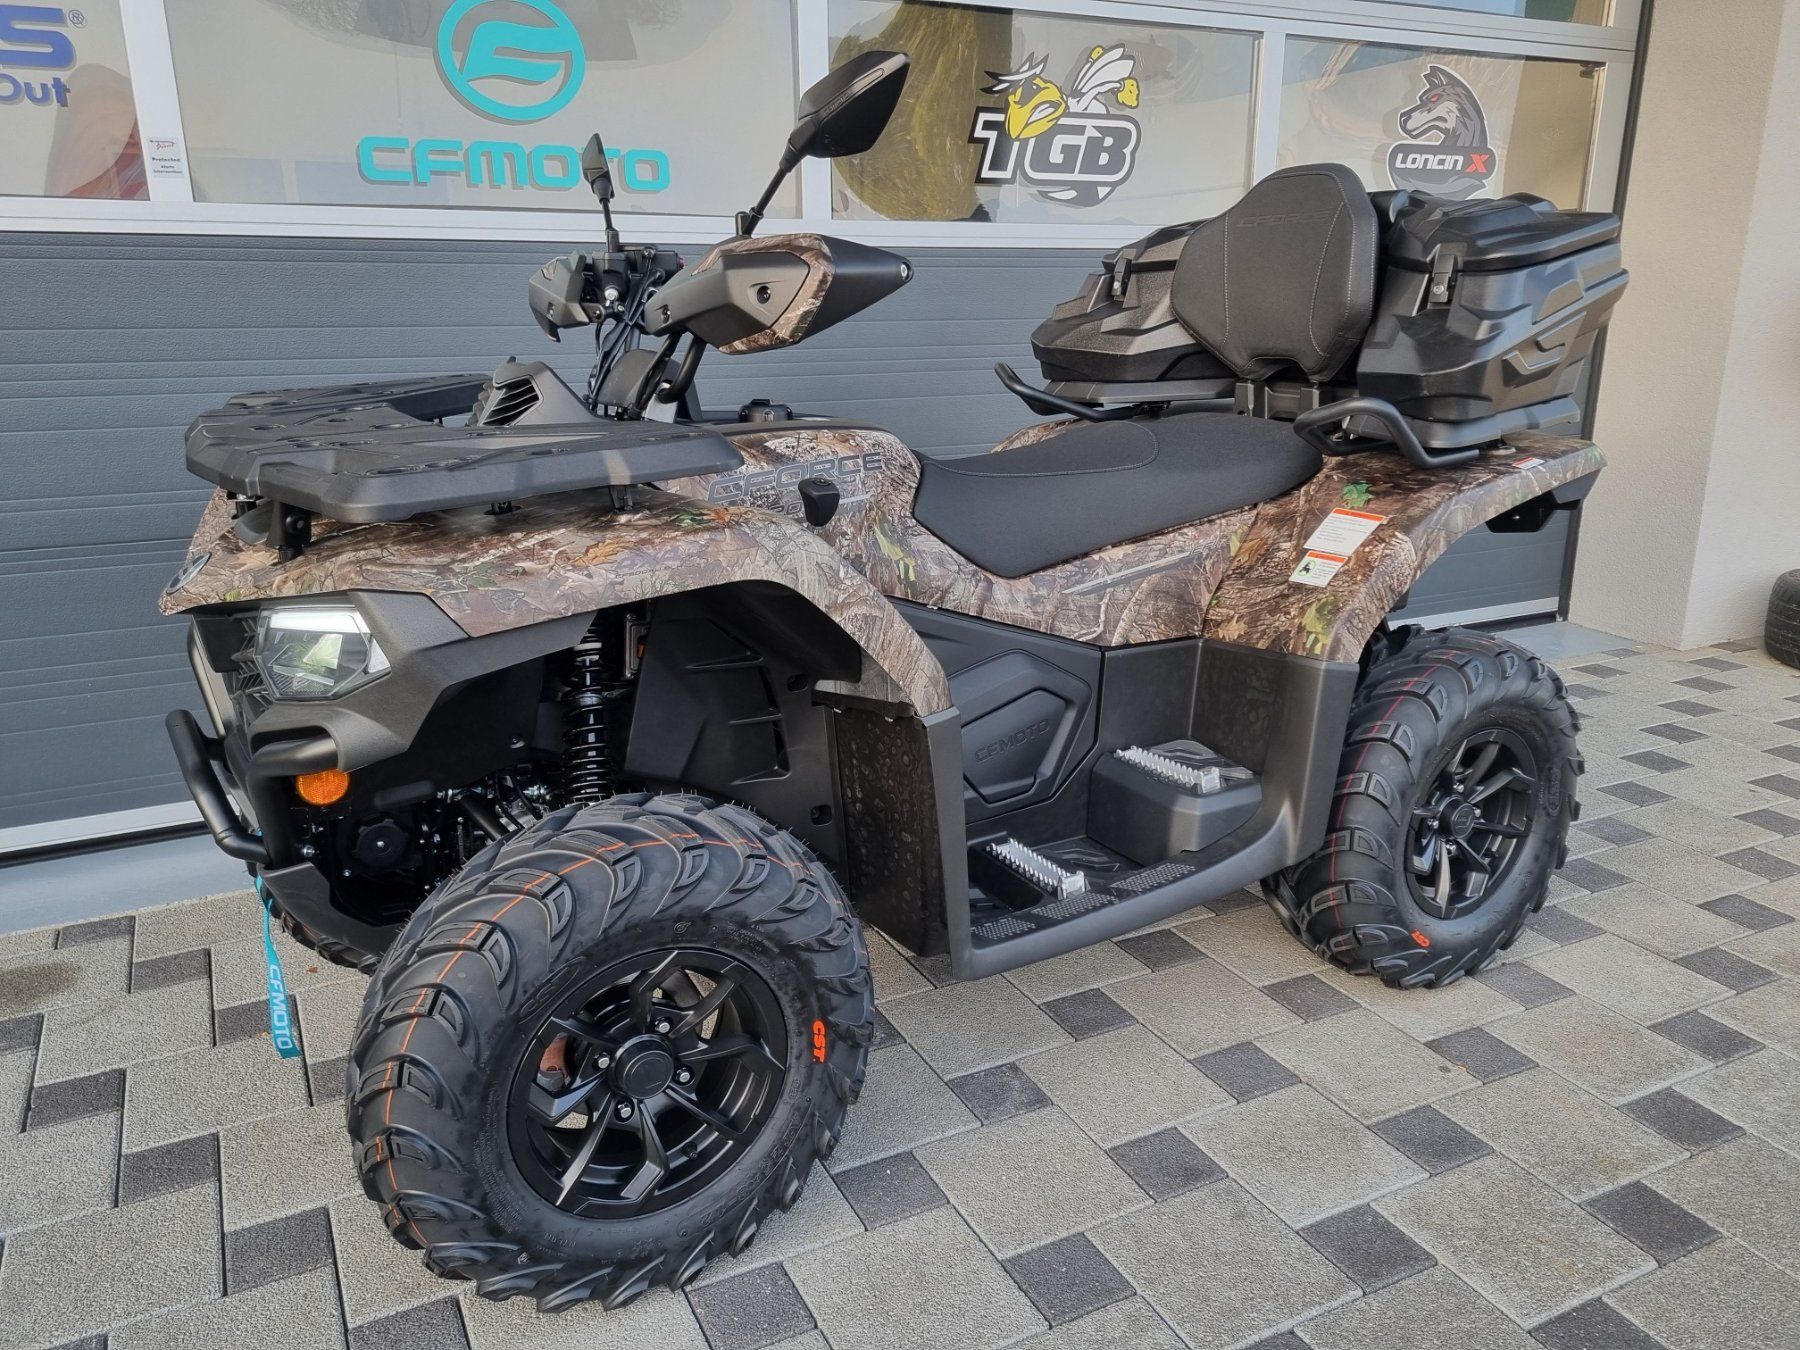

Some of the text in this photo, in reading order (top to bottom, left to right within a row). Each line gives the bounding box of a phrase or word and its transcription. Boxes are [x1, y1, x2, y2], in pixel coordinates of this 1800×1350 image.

[969, 106, 1142, 188] TGB
[1395, 153, 1490, 173] LONCIN X
[707, 452, 883, 503] CFORCE
[974, 718, 1050, 765] CFMOTO
[269, 964, 294, 1050] CFMOTO
[812, 1019, 827, 1064] CST
